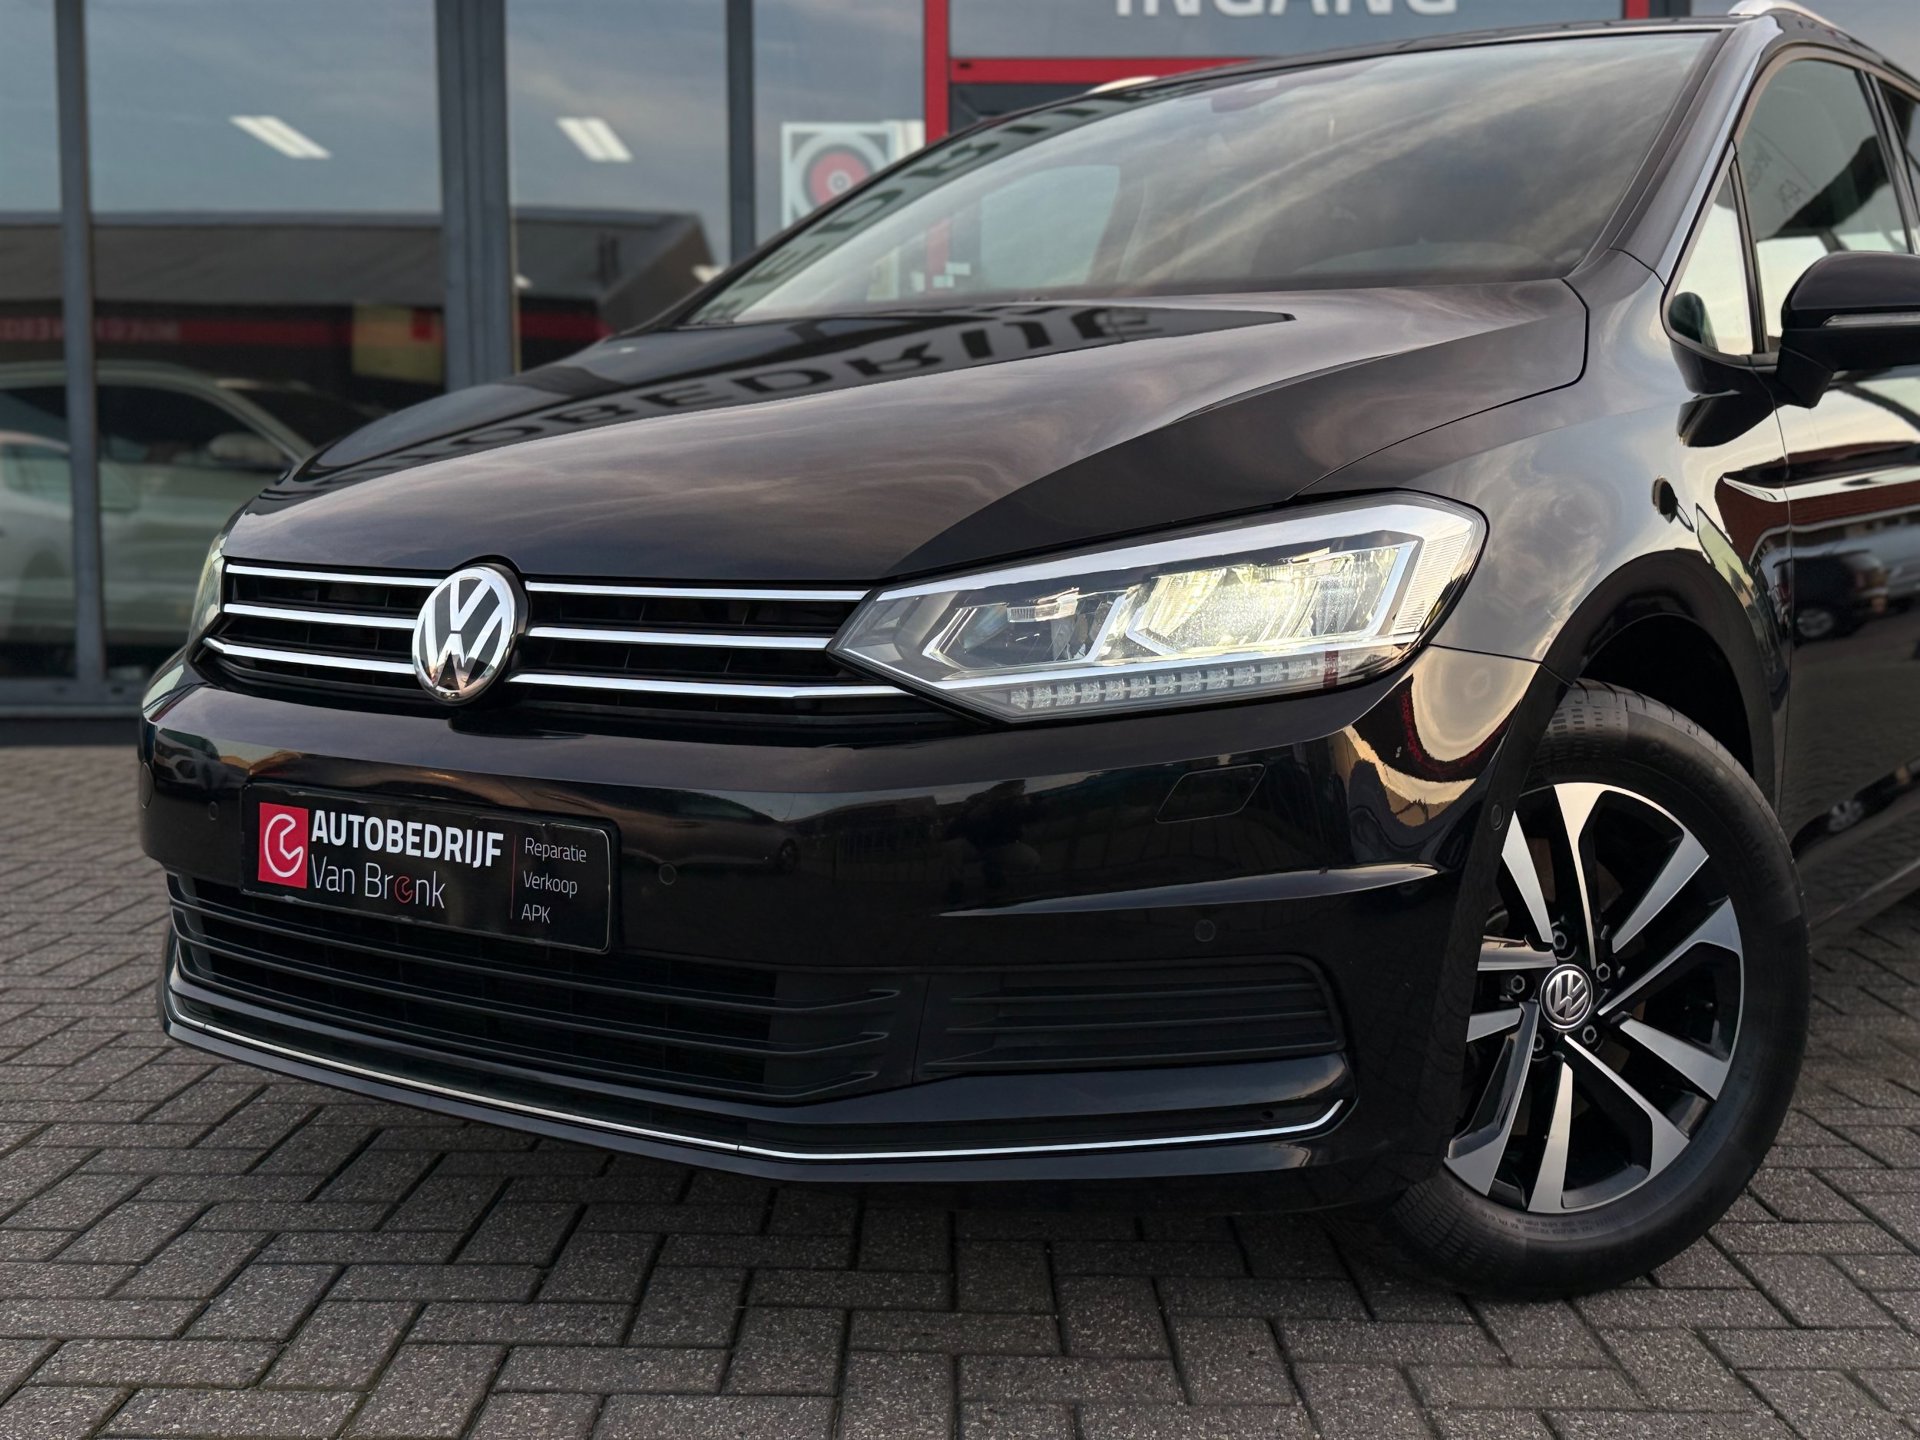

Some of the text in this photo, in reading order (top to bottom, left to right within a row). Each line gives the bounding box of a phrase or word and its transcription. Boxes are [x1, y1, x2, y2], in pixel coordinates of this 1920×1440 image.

[311, 809, 504, 868] AUTOBEDRIJF
[525, 837, 587, 862] Reparatie
[311, 853, 356, 895] Van
[523, 870, 578, 898] Verkoop
[521, 903, 551, 924] APK
